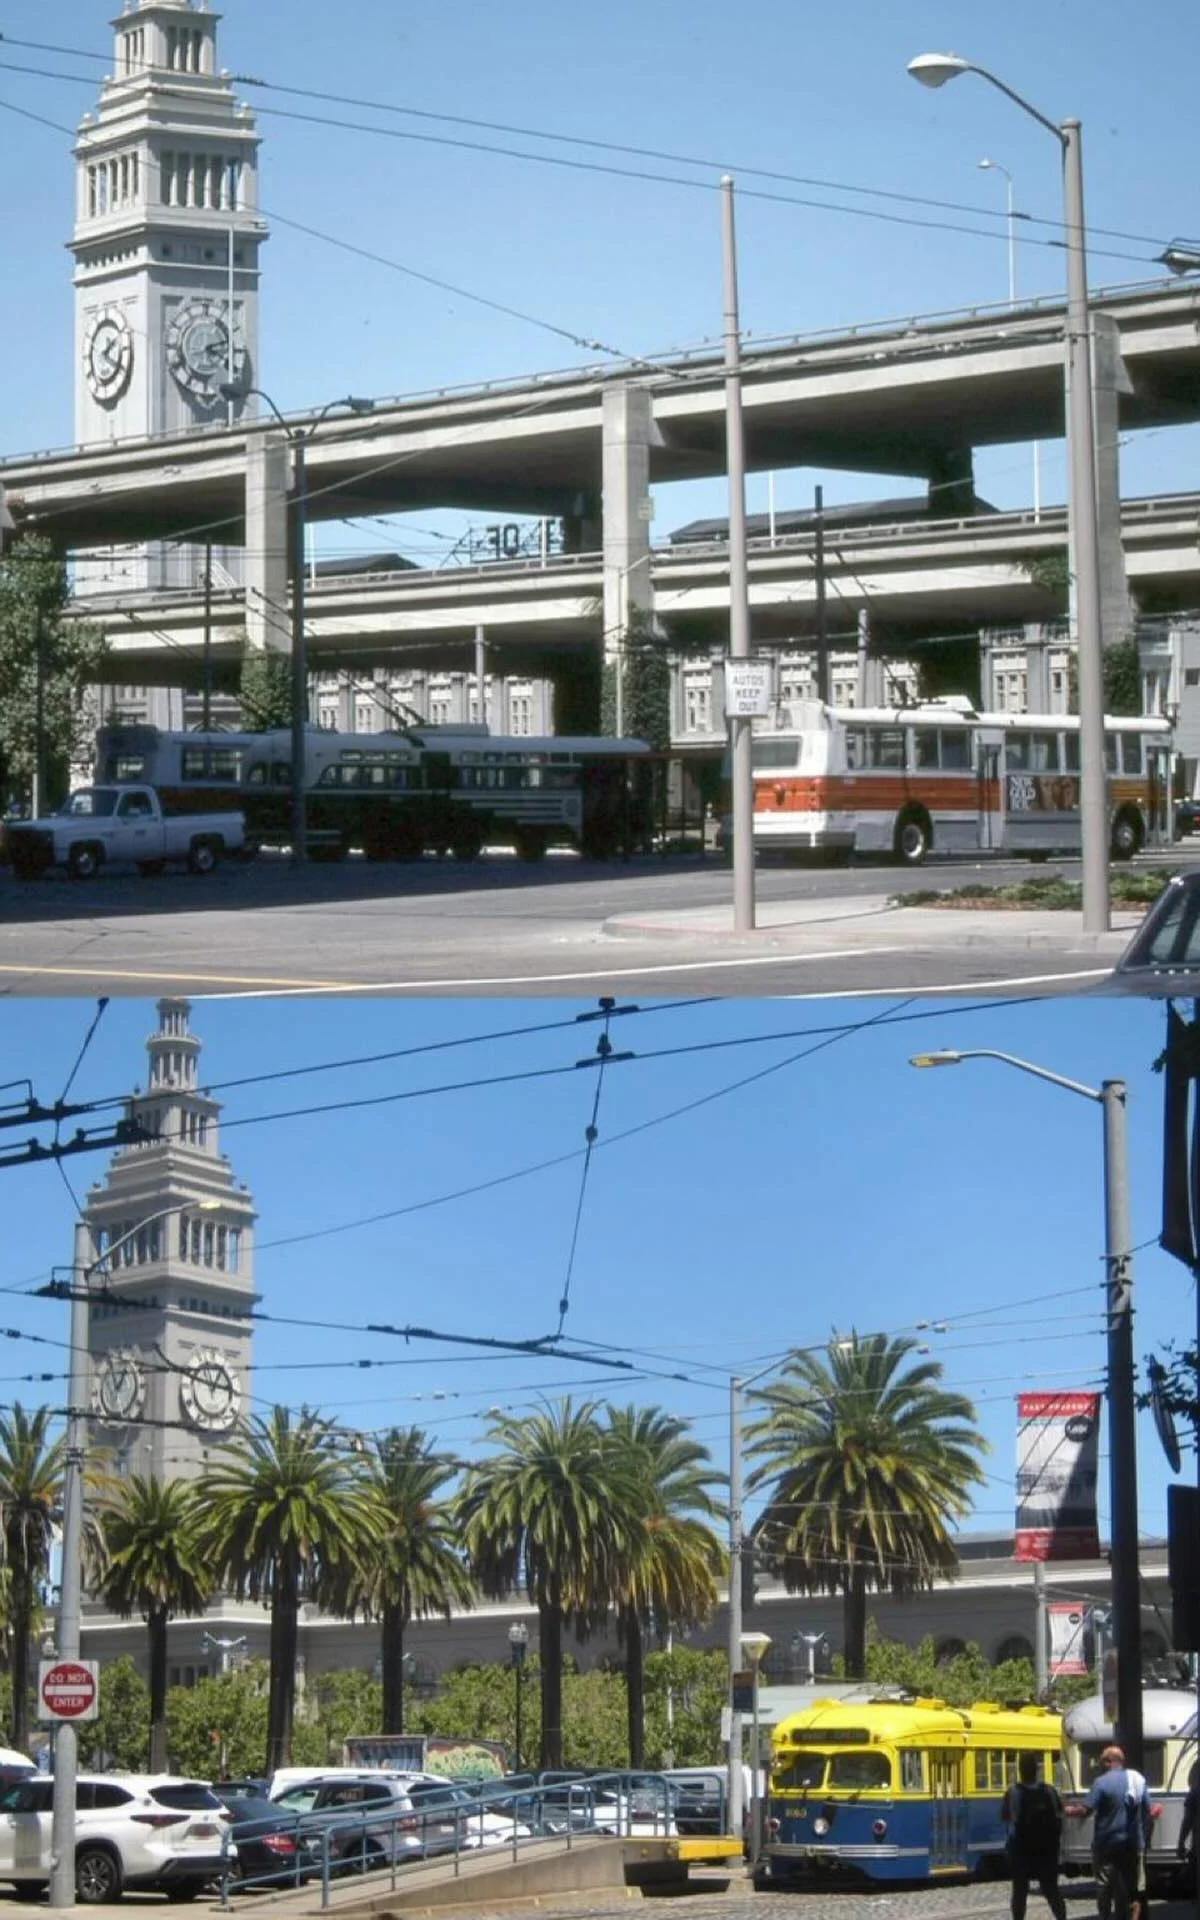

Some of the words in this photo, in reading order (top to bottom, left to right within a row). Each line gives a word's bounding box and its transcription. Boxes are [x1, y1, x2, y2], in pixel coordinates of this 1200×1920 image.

[732, 674, 765, 686] AUTOS
[736, 688, 761, 699] KEEP
[738, 701, 758, 711] OUT
[50, 1672, 64, 1683] DO
[66, 1672, 87, 1683] NOT
[53, 1697, 85, 1708] ENTER
